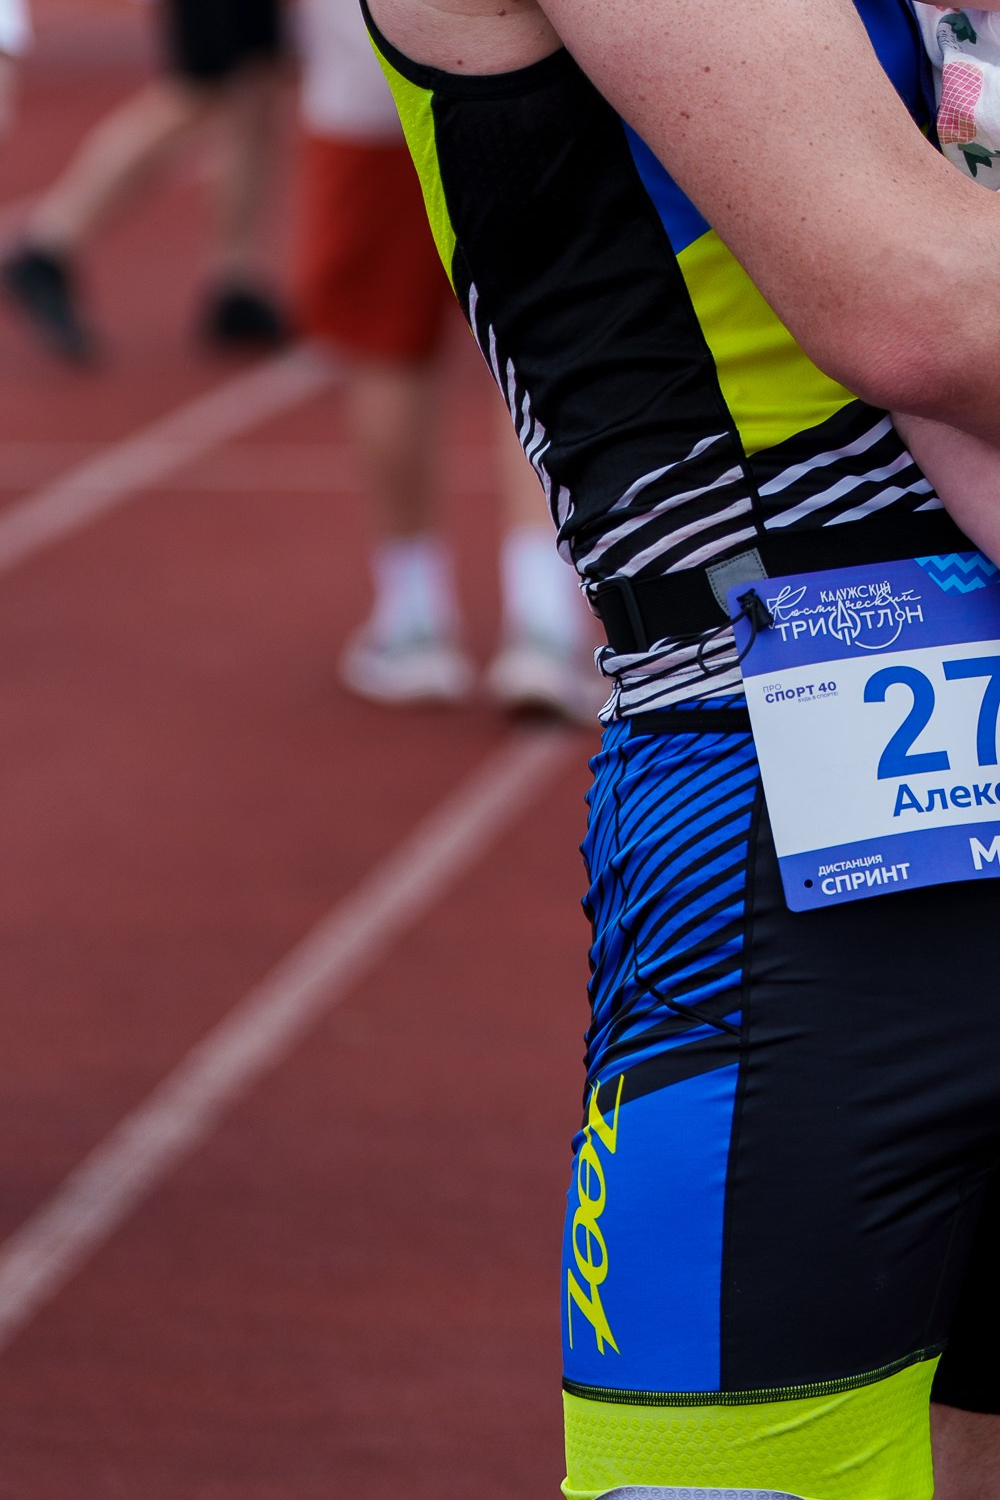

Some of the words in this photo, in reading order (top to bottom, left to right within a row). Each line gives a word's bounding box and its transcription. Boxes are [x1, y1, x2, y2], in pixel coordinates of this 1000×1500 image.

[820, 581, 892, 603] КАЛУЖСКИЙ
[763, 684, 782, 693] ПРО
[765, 685, 814, 703] СПОРТ
[818, 681, 837, 692] 40
[818, 854, 883, 877] ДИСТАНЦИЯ
[821, 862, 910, 896] СПРИНТ
